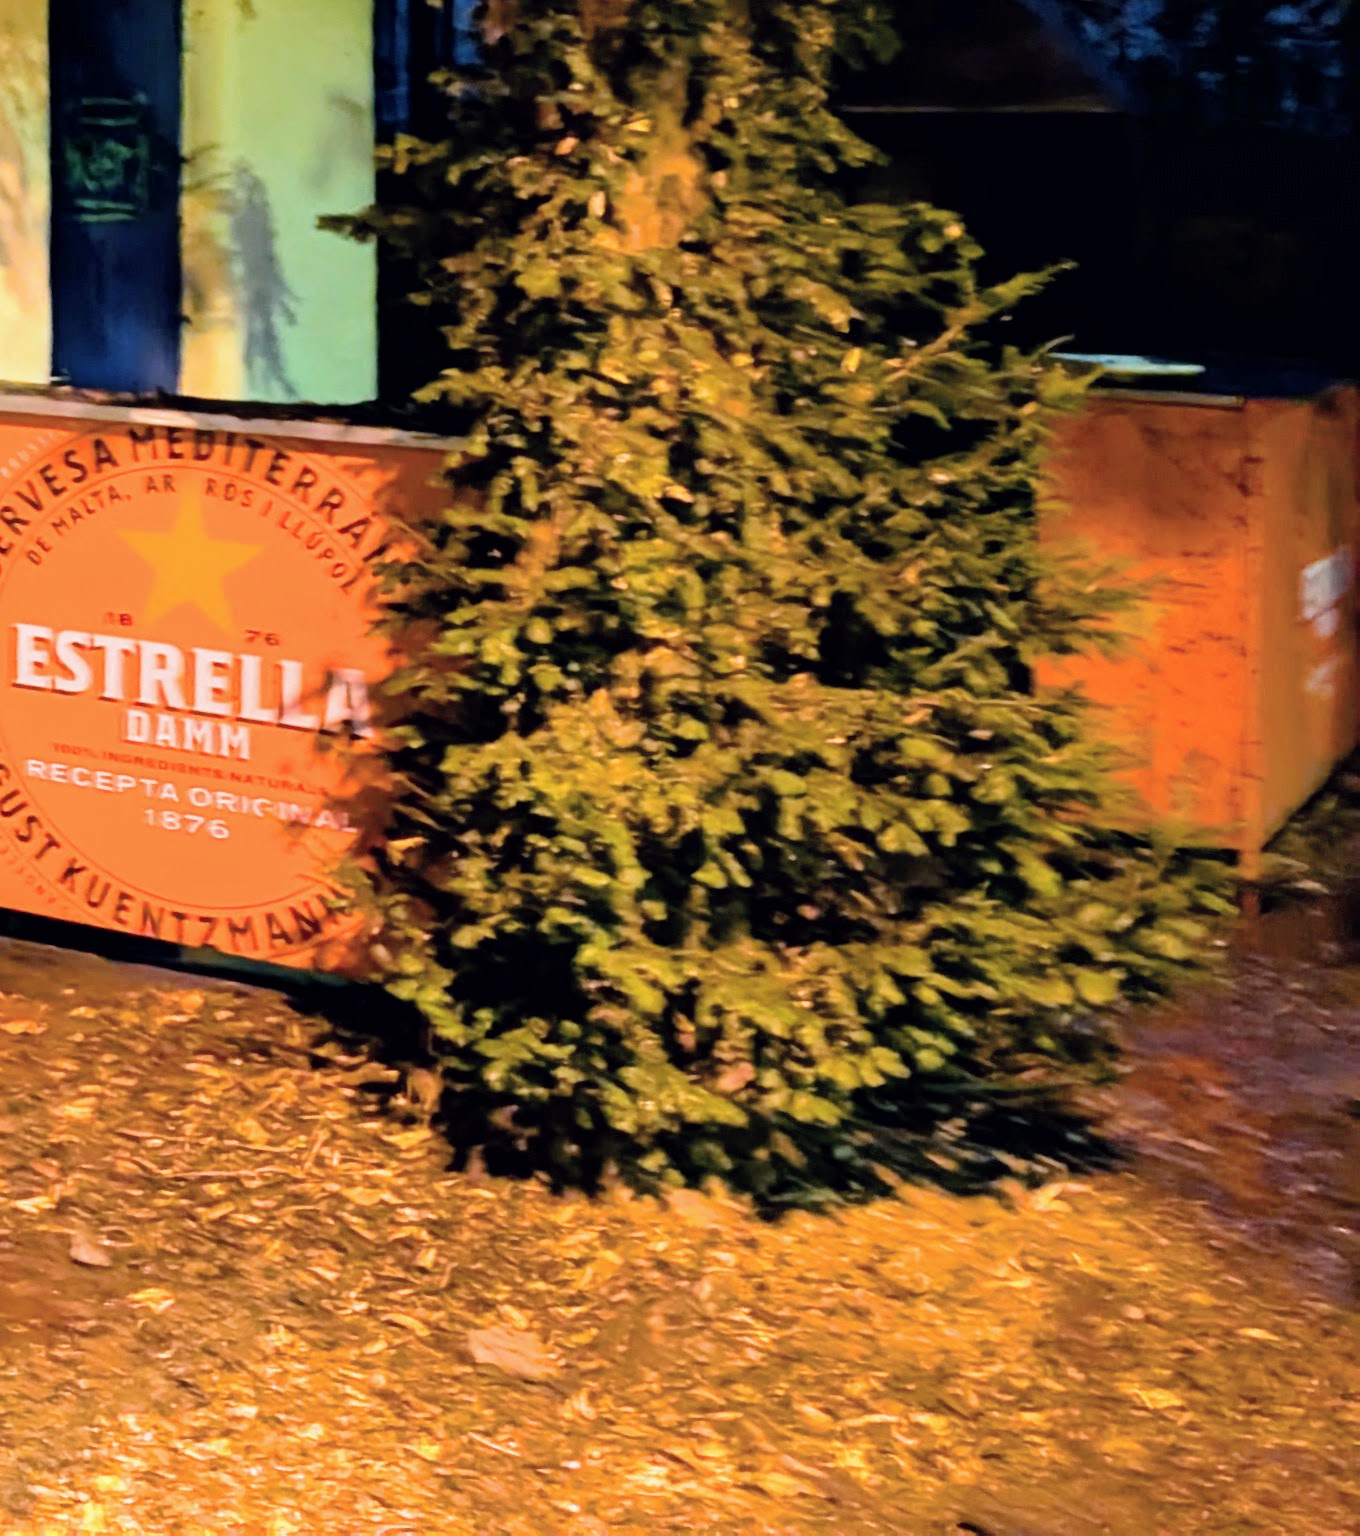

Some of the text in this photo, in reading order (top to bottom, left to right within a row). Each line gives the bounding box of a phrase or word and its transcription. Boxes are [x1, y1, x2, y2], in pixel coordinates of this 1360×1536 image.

[26, 535, 53, 566] DE
[51, 484, 132, 537] MALTA,
[259, 499, 274, 518] I
[106, 611, 133, 627] 18
[243, 629, 280, 647] 76
[12, 622, 373, 740] ESTRELLA
[124, 708, 251, 762] DAMM
[26, 758, 180, 803] RECEPTA
[143, 808, 230, 839] 1876
